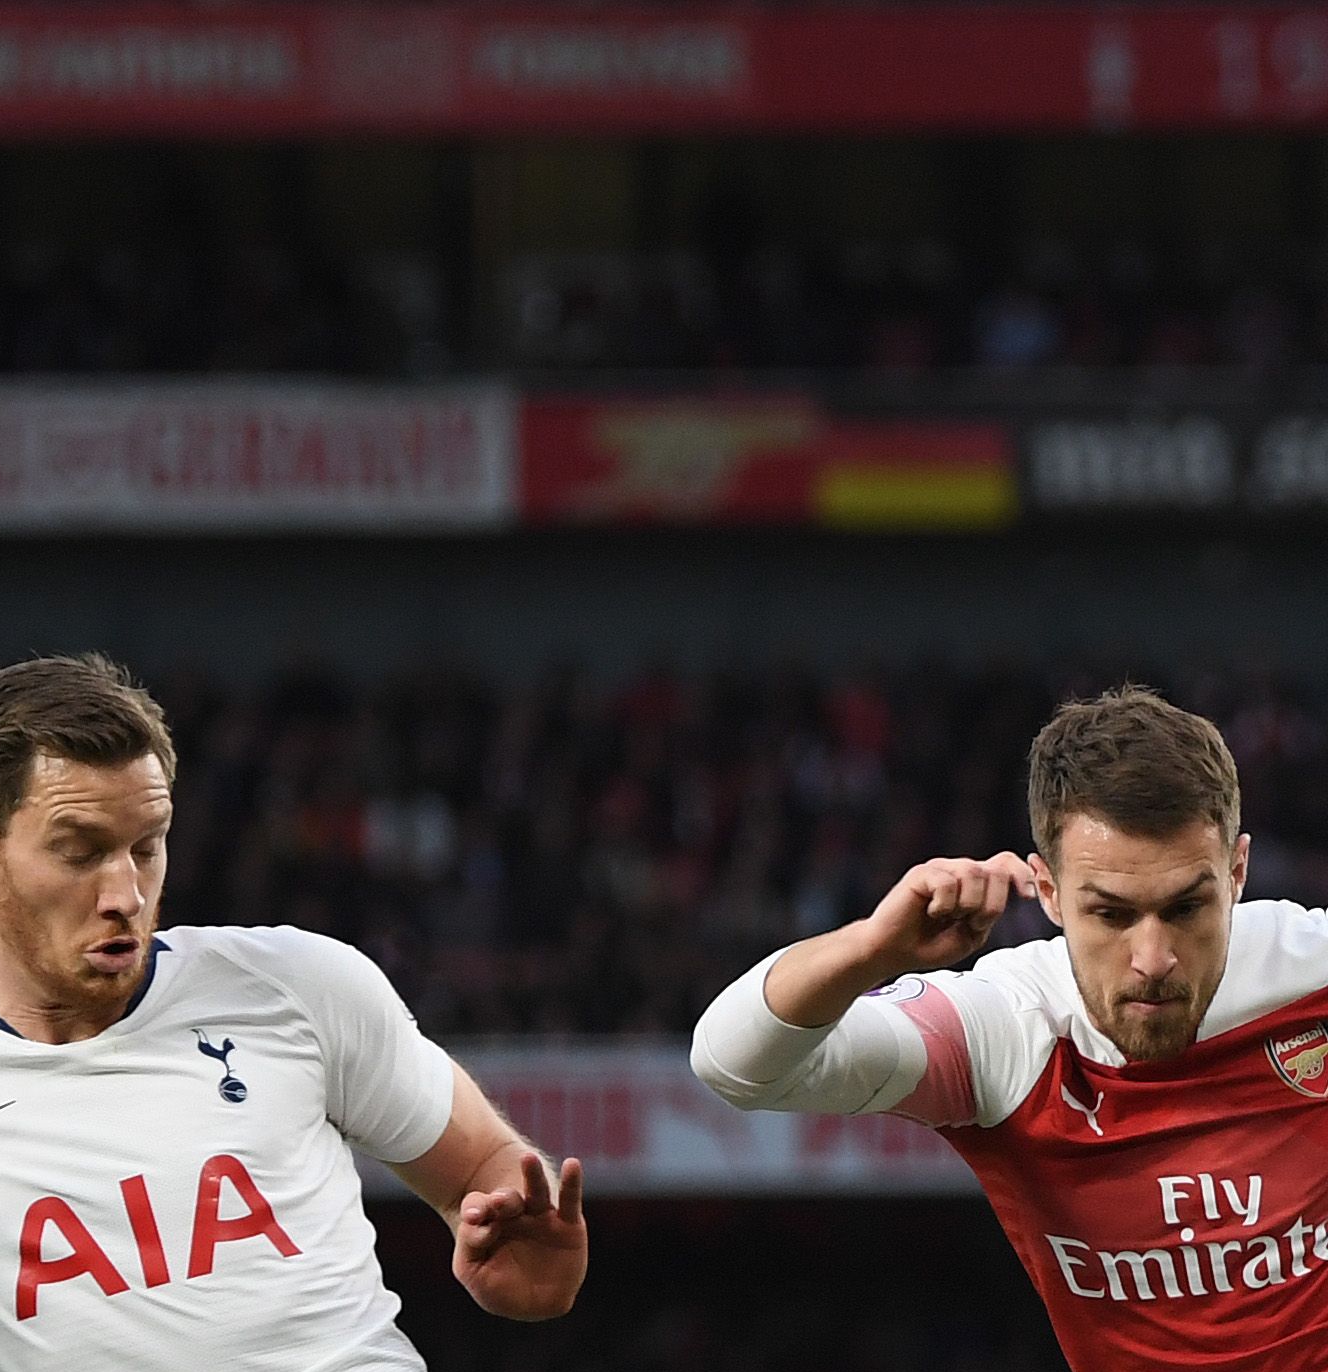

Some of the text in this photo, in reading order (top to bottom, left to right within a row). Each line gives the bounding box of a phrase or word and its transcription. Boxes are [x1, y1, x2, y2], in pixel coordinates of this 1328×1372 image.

[1275, 1024, 1323, 1056] Arsenal
[1157, 1173, 1262, 1226] Fly
[16, 1154, 303, 1321] AIA
